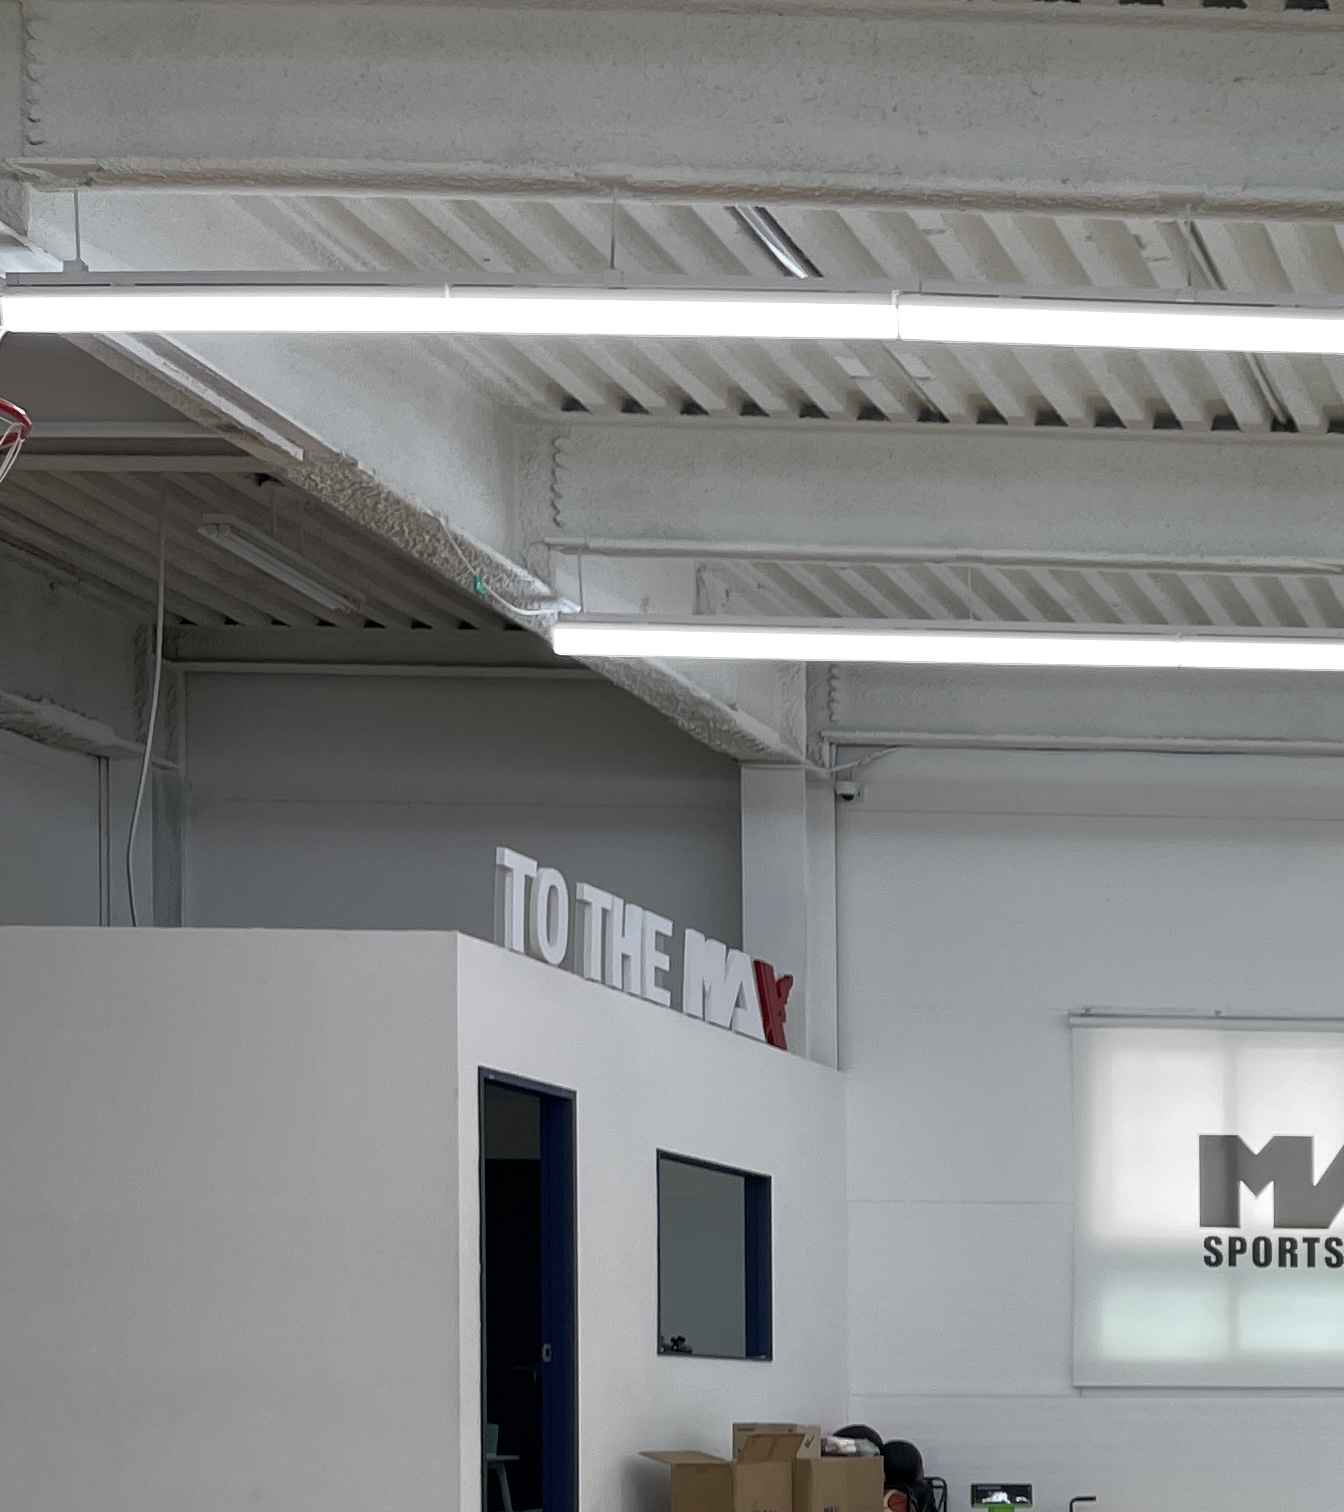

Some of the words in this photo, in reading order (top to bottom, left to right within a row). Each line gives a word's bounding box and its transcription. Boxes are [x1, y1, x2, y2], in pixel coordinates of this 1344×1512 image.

[496, 847, 568, 965] TO
[576, 882, 673, 1007] THE
[684, 928, 793, 1050] MAX
[1204, 1236, 1344, 1268] SPORTS
